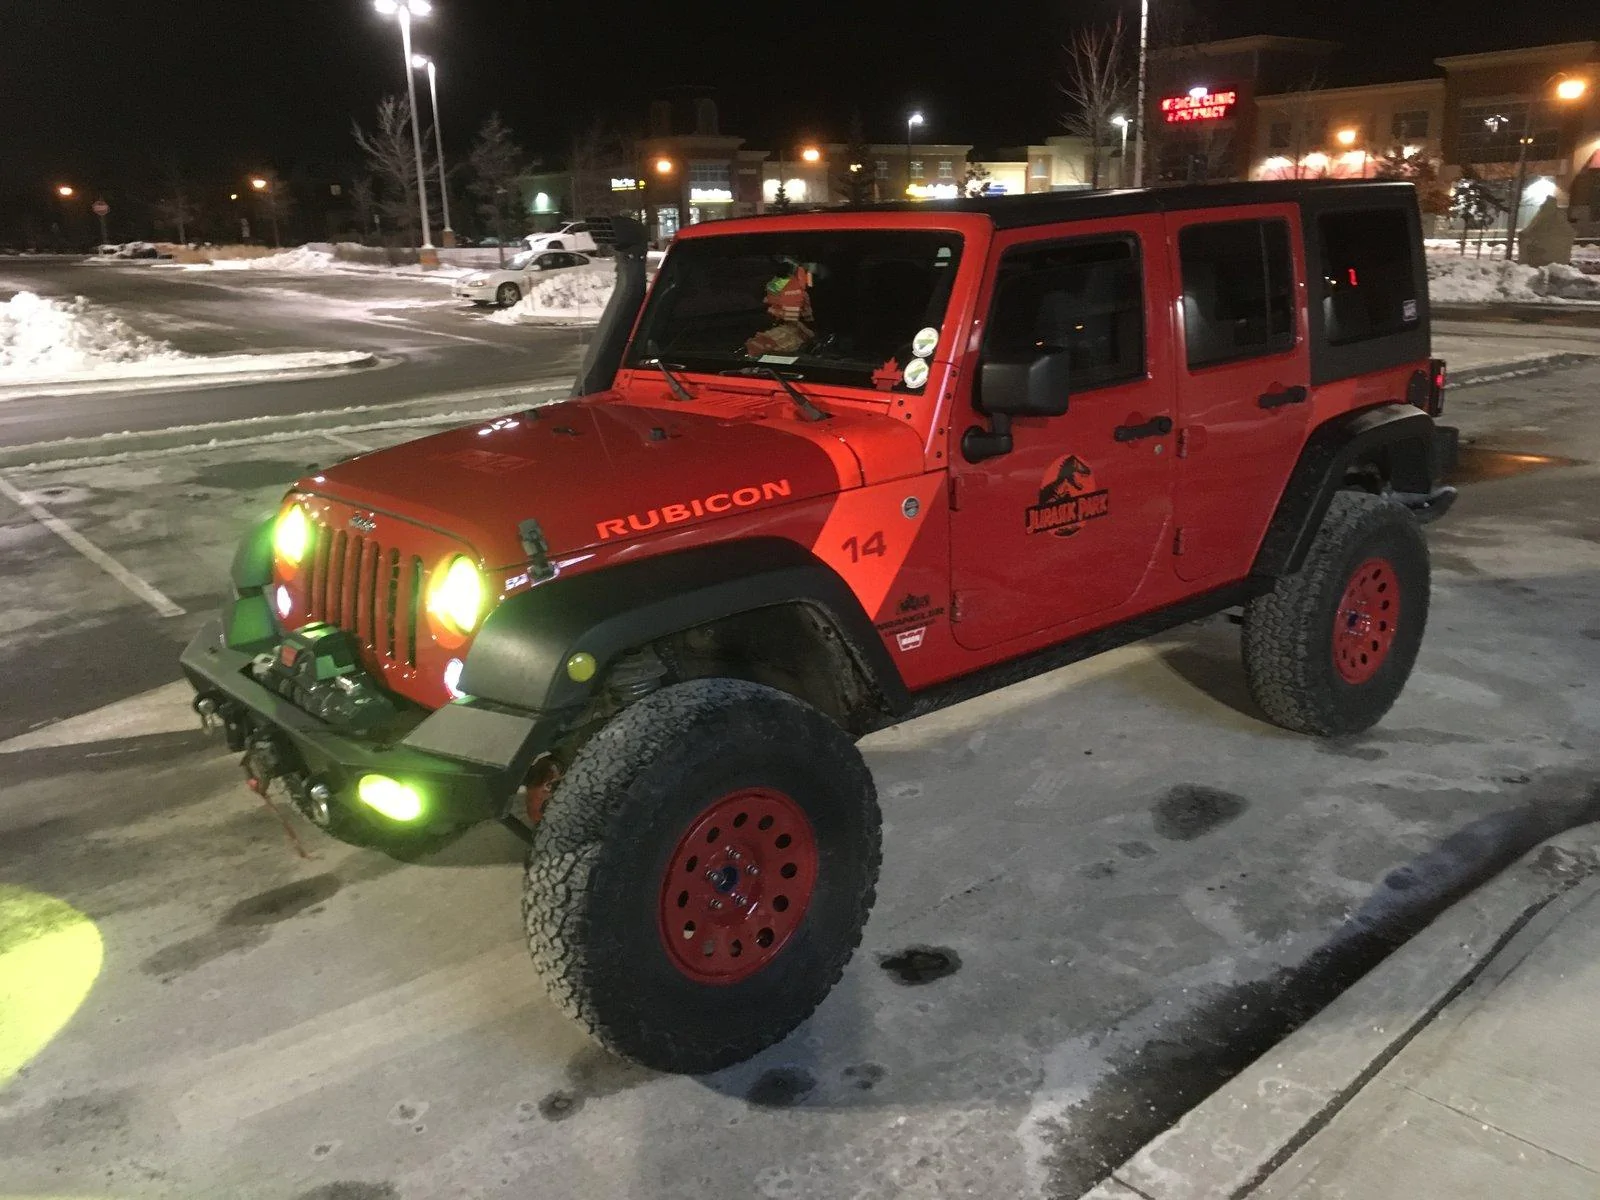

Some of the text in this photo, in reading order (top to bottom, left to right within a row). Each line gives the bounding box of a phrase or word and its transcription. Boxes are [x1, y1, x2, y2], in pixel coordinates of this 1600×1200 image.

[1203, 91, 1235, 106] CLINIC
[596, 479, 791, 539] RUBICON
[841, 531, 886, 562] 14
